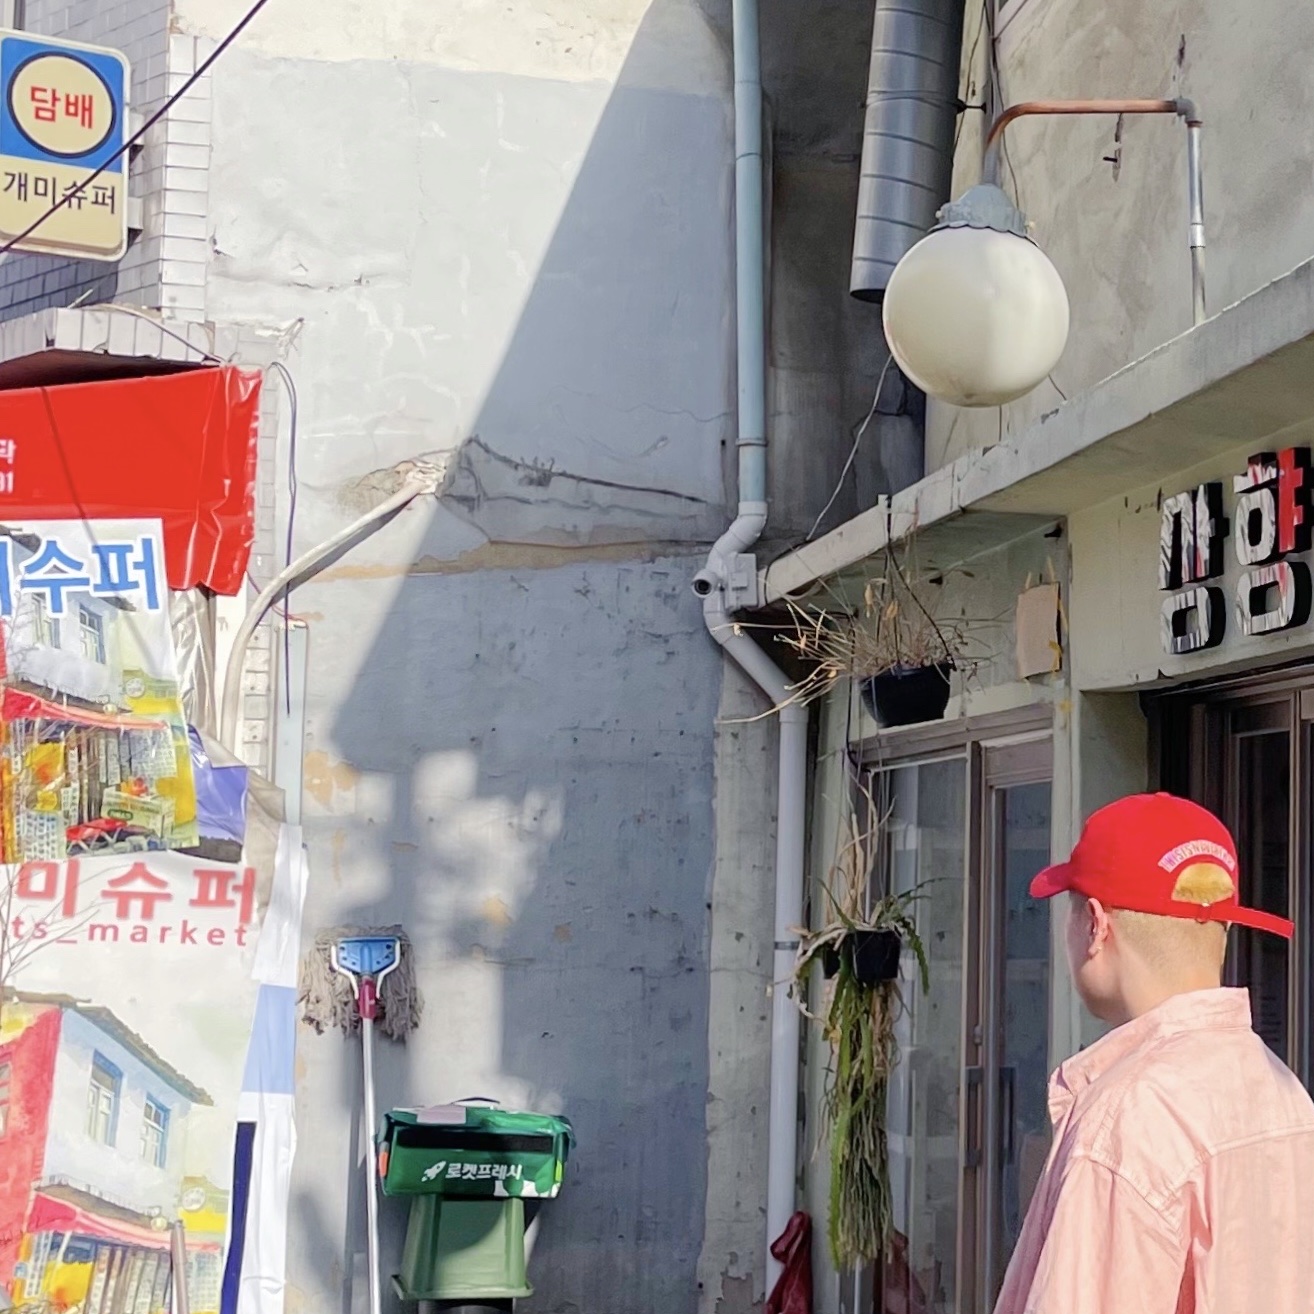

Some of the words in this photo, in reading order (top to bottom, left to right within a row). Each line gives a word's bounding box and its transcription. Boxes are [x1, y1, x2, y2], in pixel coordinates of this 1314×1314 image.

[30, 86, 93, 129] 담배
[3, 171, 116, 214] 개미슈퍼
[12, 917, 247, 947] ts_market
[445, 1163, 522, 1181] 로켓프레시
